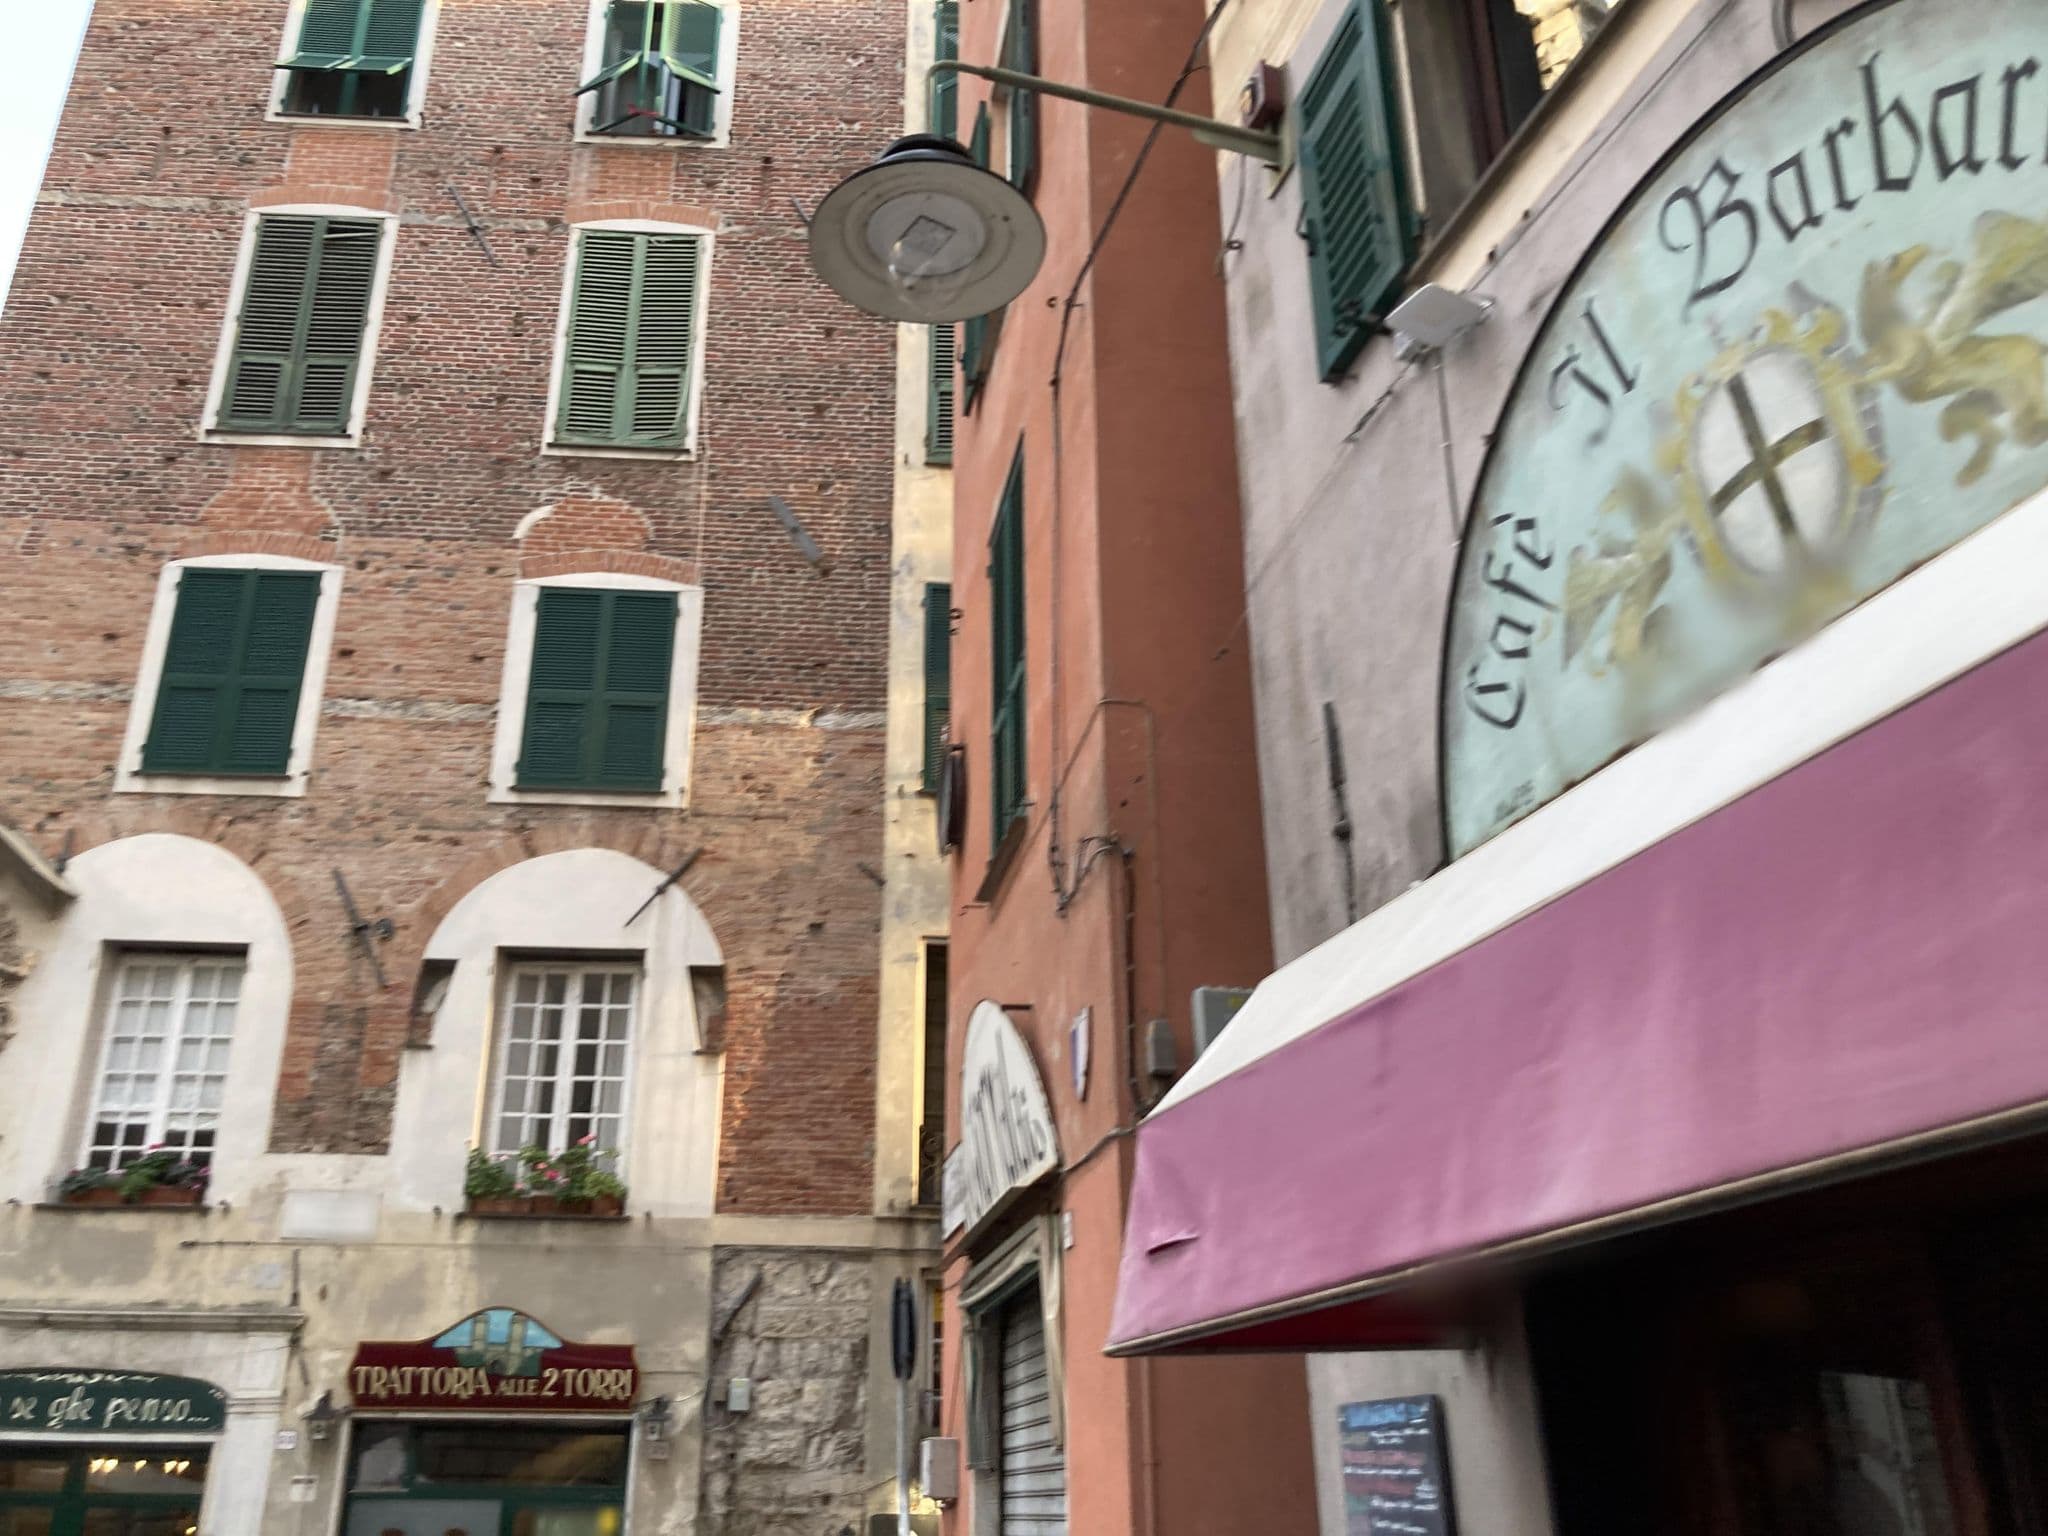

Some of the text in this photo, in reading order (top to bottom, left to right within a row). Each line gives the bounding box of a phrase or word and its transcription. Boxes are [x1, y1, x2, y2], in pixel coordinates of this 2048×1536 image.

[1658, 50, 2048, 322] Barbar
[354, 1366, 633, 1400] TRATTORIA ALLE 2 TORRI
